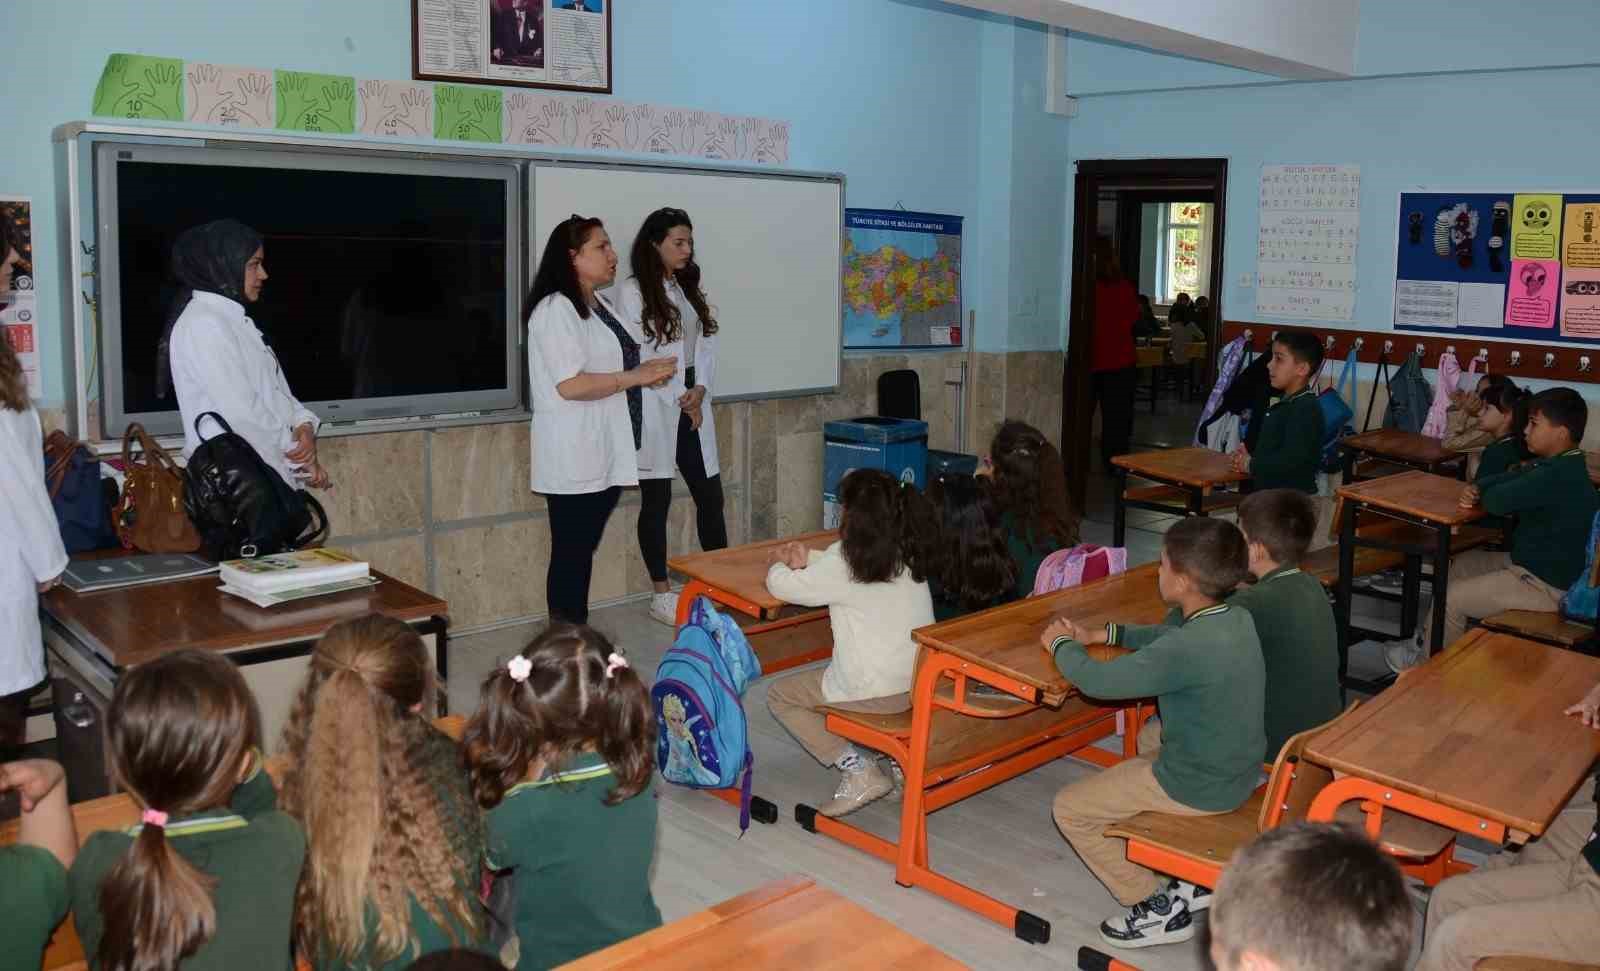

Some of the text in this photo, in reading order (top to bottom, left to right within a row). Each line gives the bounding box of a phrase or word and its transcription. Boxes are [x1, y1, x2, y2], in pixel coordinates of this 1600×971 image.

[126, 100, 143, 112] 10
[305, 113, 319, 125] 30
[526, 128, 537, 137] 60
